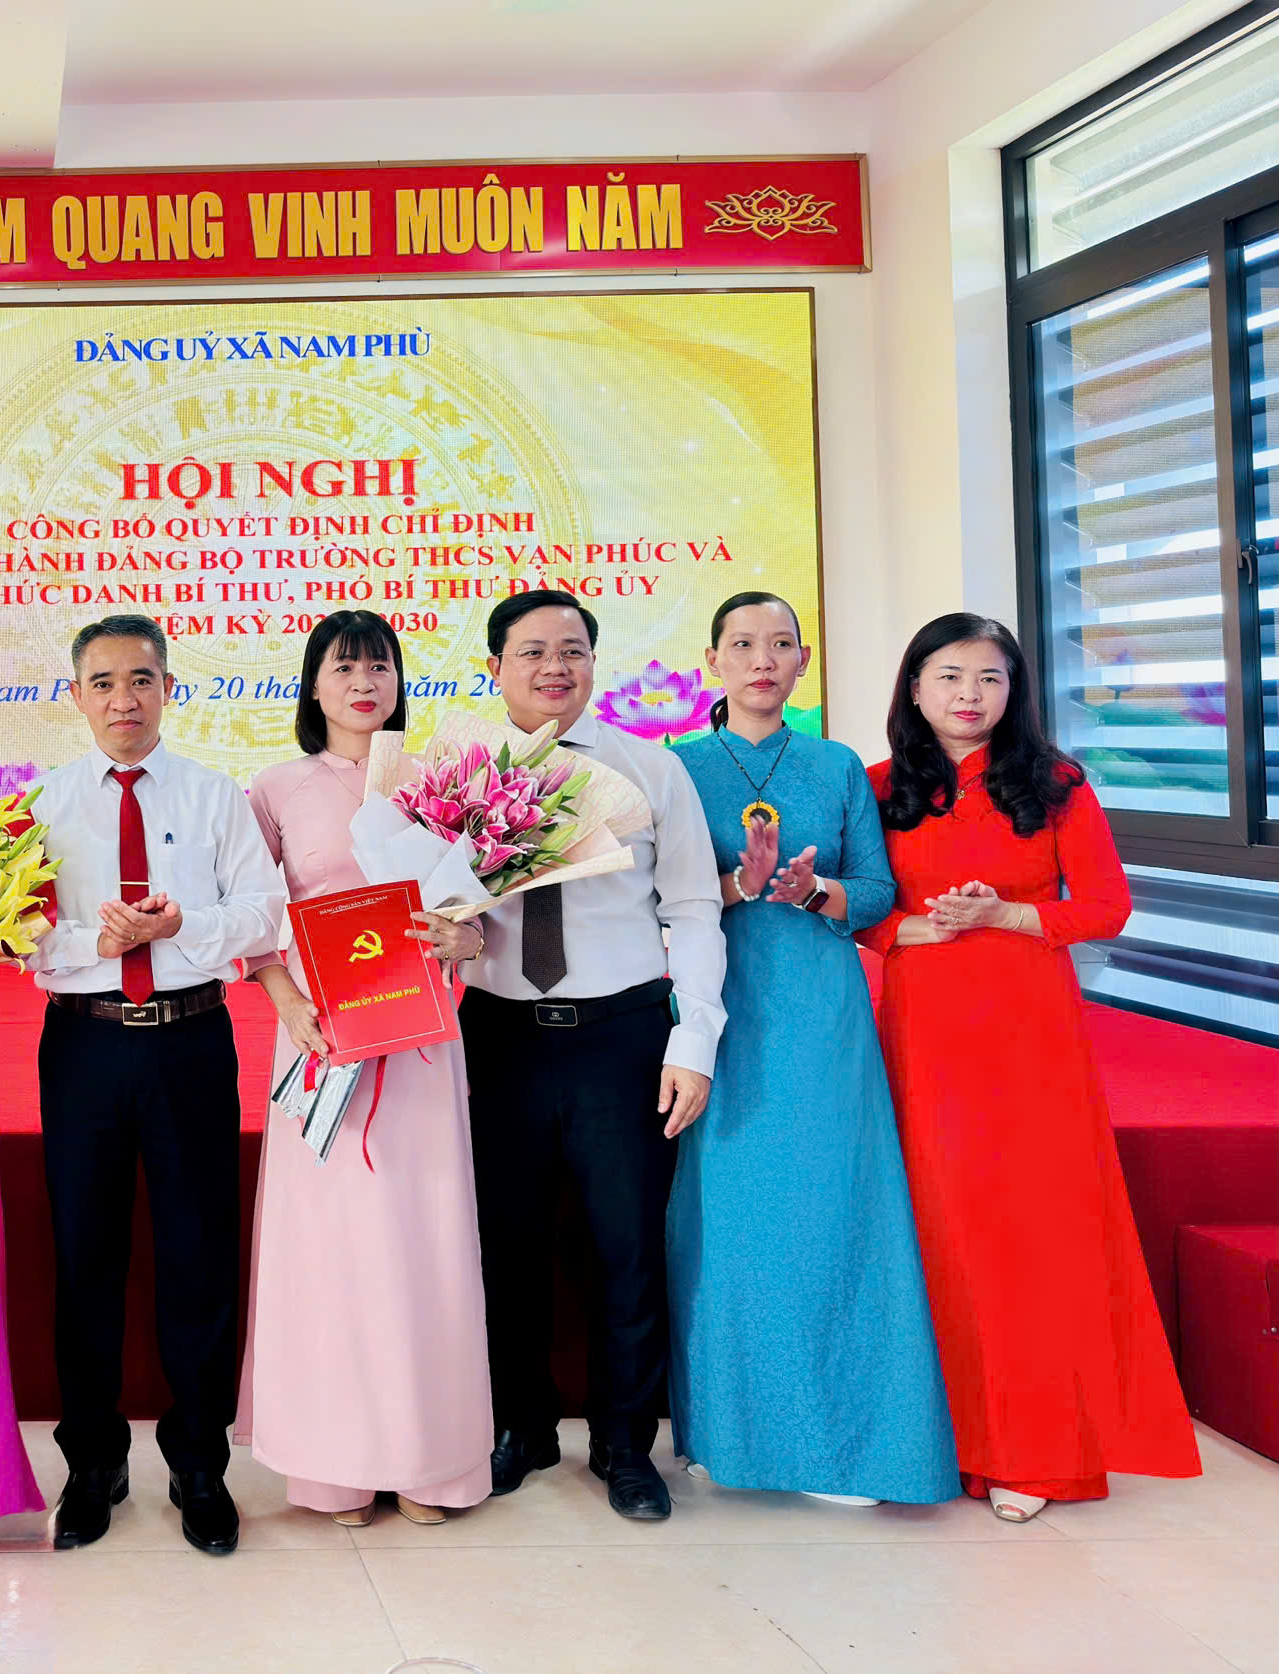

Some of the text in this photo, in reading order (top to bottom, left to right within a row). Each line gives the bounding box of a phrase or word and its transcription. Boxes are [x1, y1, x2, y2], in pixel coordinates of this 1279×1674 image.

[52, 191, 226, 271] QUANG
[248, 190, 372, 259] VINH
[395, 174, 545, 256] MUÔN
[566, 171, 683, 253] NĂM
[75, 326, 431, 362] ĐẢNG UỶ XÃ NAM PHÙ
[119, 456, 420, 511] HỘI NGHỊ
[6, 508, 535, 541] CÔNG BỐ QUYẾT ĐỊNH CHỈ ĐỊNH
[95, 545, 189, 571] ĐẢNG
[199, 547, 244, 575] BỘ
[253, 542, 396, 569] TRƯỜNG
[406, 546, 494, 567] THCS
[504, 545, 573, 570] VẠN
[585, 537, 677, 564] PHÚC
[686, 535, 733, 561] VÀ
[71, 583, 163, 604] DANH
[174, 576, 205, 602] BÍ
[214, 578, 295, 604] THƯ,
[305, 574, 373, 601] PHÓ
[383, 573, 414, 600] BÍ
[425, 575, 500, 599] THƯ
[507, 571, 603, 597] ĐẢNG
[614, 569, 661, 596] ỦY
[225, 608, 271, 635] KỲ
[208, 675, 245, 700] 20
[255, 675, 301, 699] thá
[469, 673, 503, 697] 20
